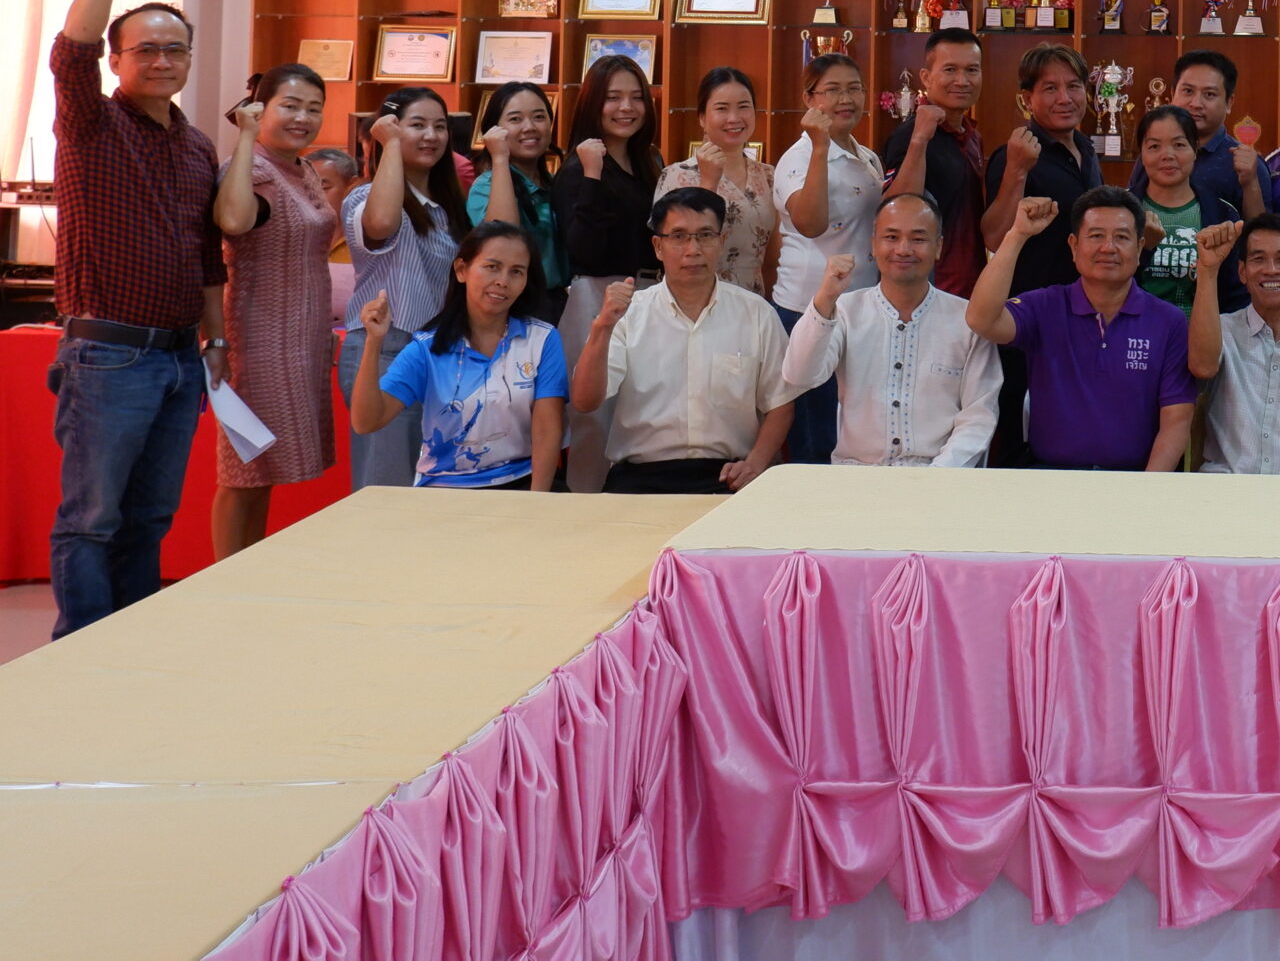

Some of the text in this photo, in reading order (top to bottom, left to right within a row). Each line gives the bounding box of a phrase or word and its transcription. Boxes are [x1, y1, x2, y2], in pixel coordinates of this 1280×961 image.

[1127, 337, 1150, 350] ทรง
[1127, 350, 1149, 360] พระ
[1125, 359, 1148, 370] เจริญ
